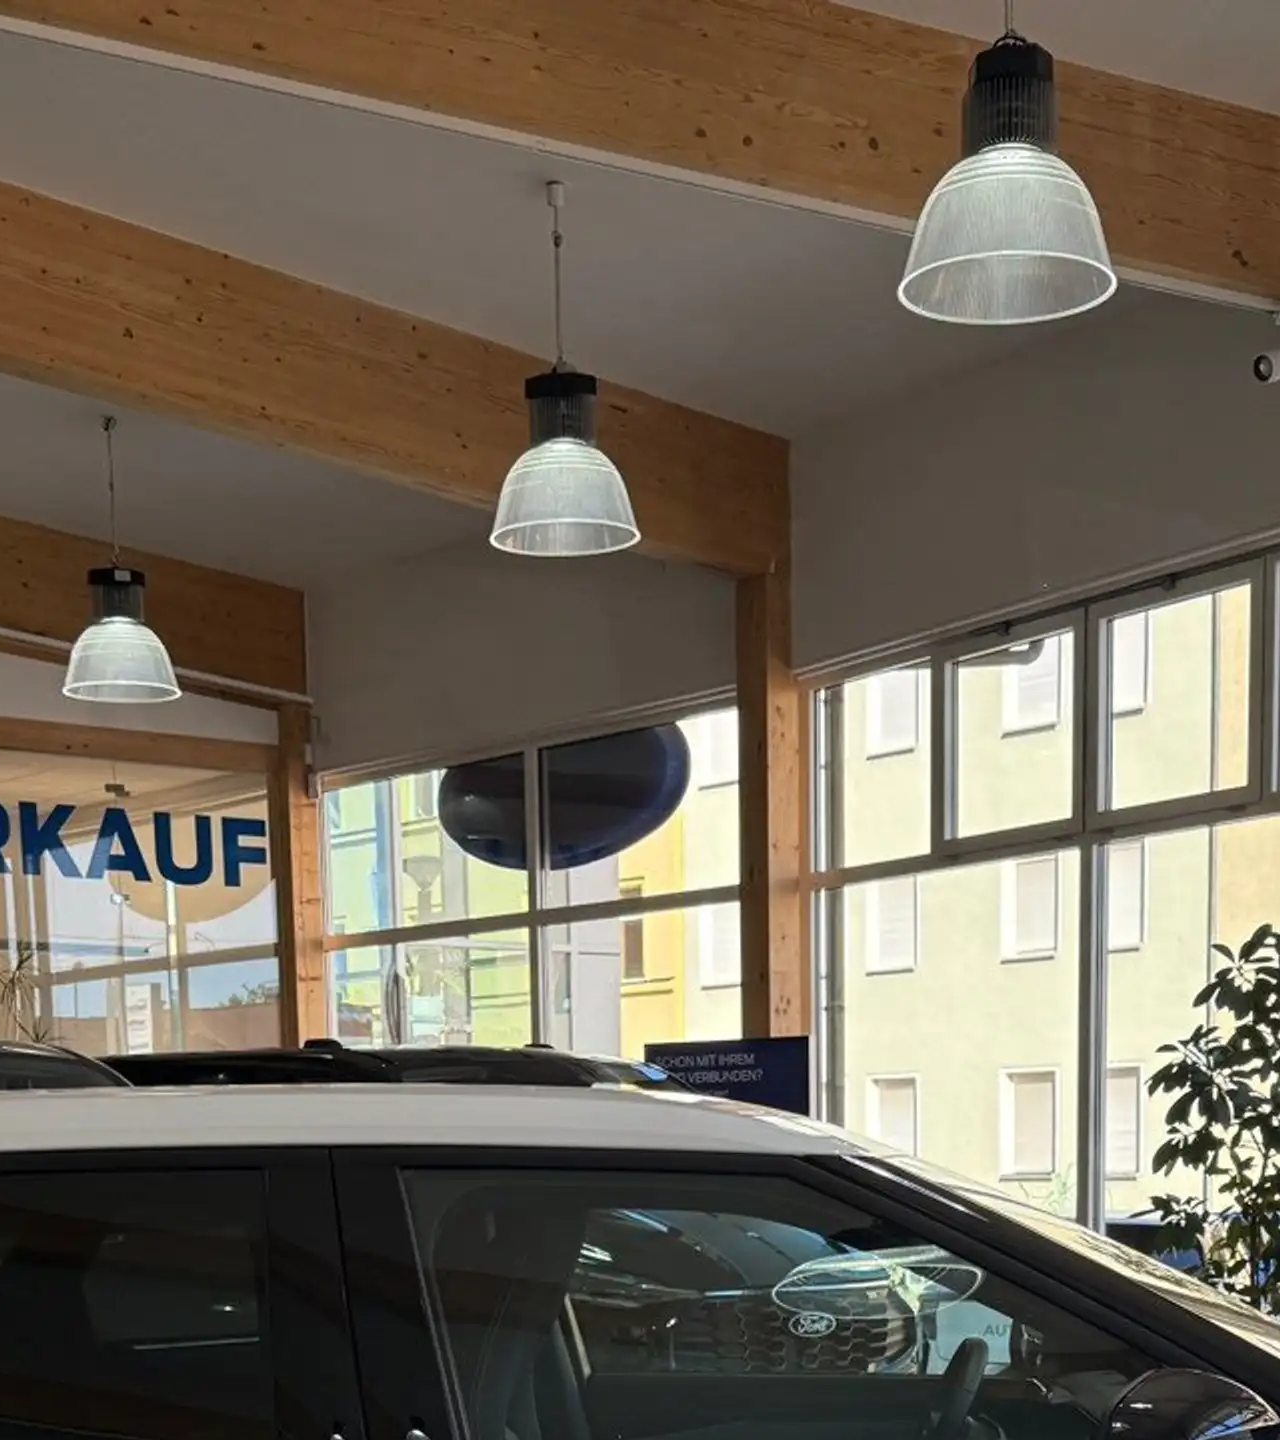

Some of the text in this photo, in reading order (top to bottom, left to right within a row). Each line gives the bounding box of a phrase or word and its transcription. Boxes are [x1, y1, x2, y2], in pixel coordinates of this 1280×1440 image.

[696, 1054, 717, 1067] MIT
[718, 1052, 756, 1067] IHREM
[687, 1069, 764, 1085] VERBUNDEN?
